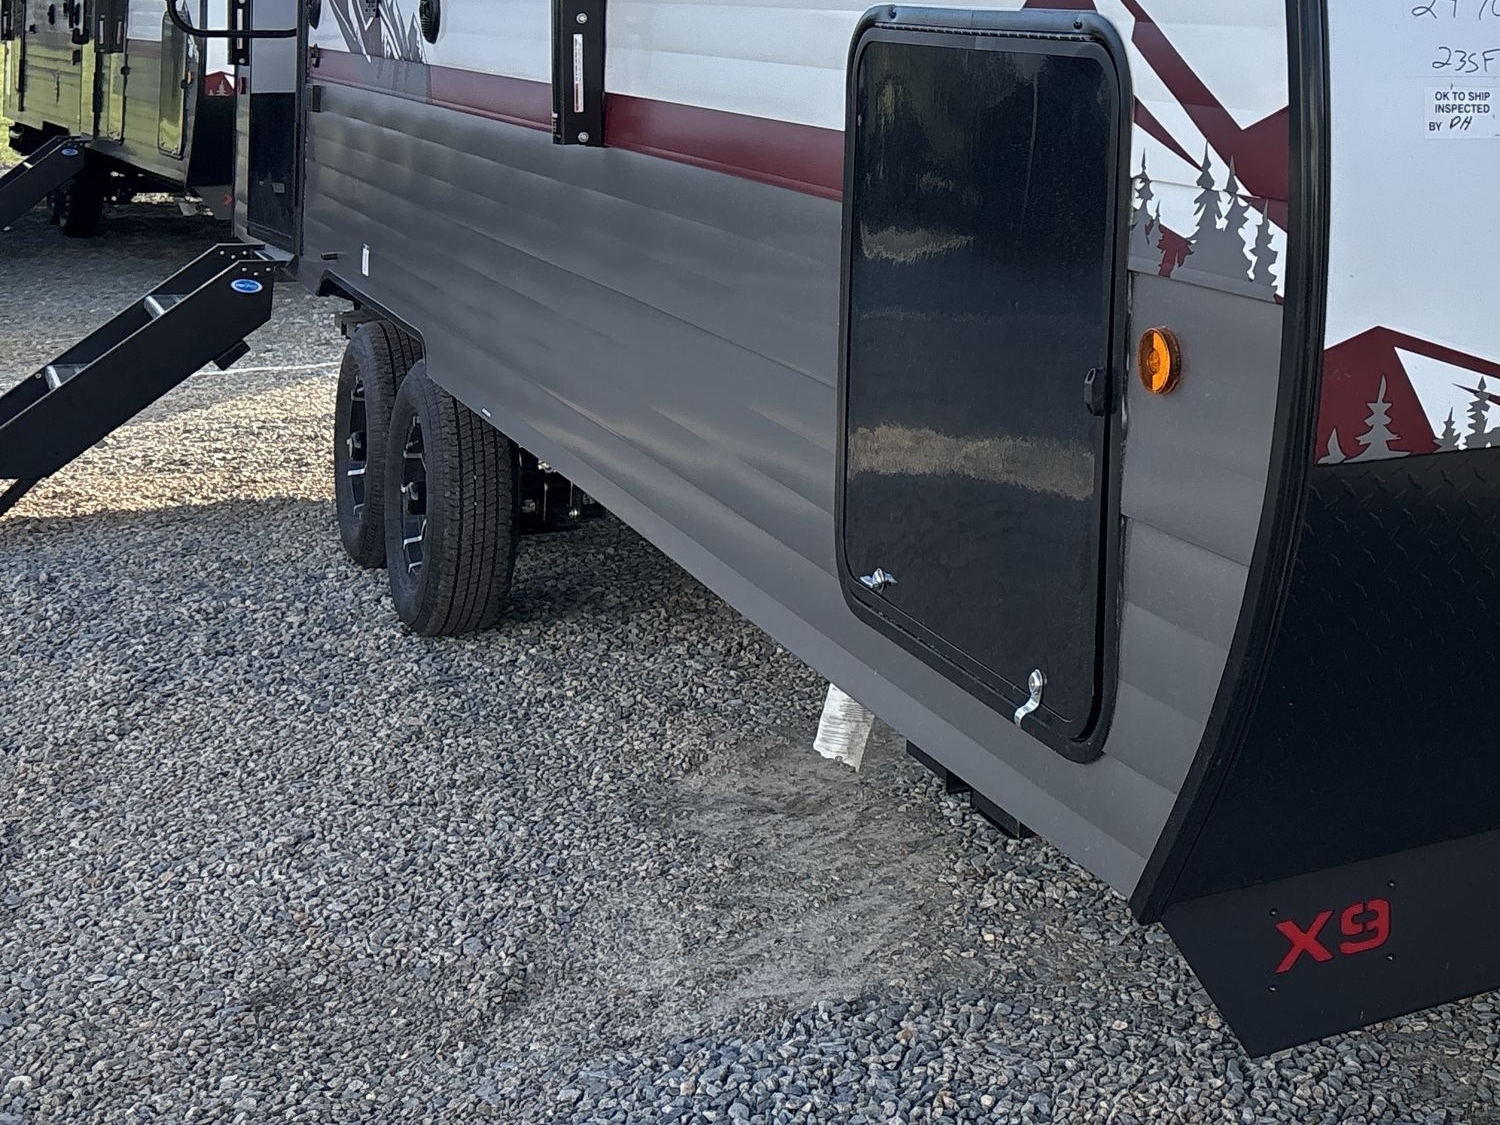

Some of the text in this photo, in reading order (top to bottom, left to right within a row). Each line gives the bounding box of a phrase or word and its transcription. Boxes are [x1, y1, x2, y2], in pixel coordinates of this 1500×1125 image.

[1434, 91, 1491, 102] OK TO SHIP
[1434, 103, 1490, 114] INSPECTED
[1429, 121, 1443, 132] BY
[1275, 897, 1392, 975] X9
